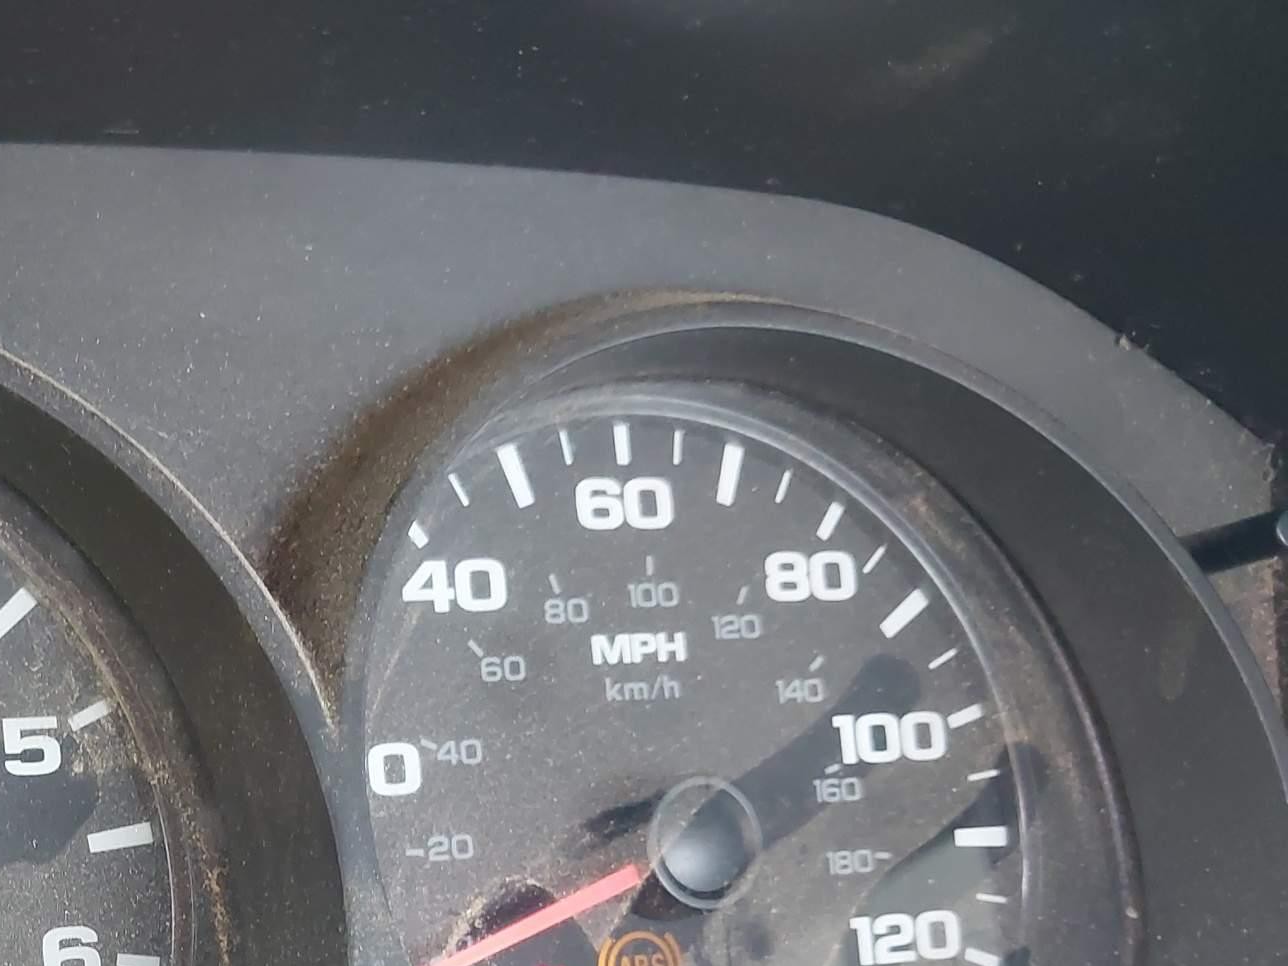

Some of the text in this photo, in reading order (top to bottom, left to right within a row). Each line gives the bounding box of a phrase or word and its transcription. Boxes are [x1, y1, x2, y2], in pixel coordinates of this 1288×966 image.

[574, 476, 674, 530] 60
[402, 557, 508, 613] 40
[763, 550, 856, 602] 80
[627, 582, 680, 608] 100
[544, 599, 590, 624] 80
[712, 614, 762, 640] 120
[591, 632, 687, 665] MPH
[480, 656, 527, 683] 60
[604, 676, 680, 701] km/h
[776, 677, 824, 703] 140
[2, 716, 61, 776] 5
[832, 710, 947, 765] 100
[437, 739, 482, 765] 40
[368, 742, 421, 796] 0
[813, 778, 862, 803] 160
[427, 834, 474, 861] 20
[827, 850, 873, 875] 180
